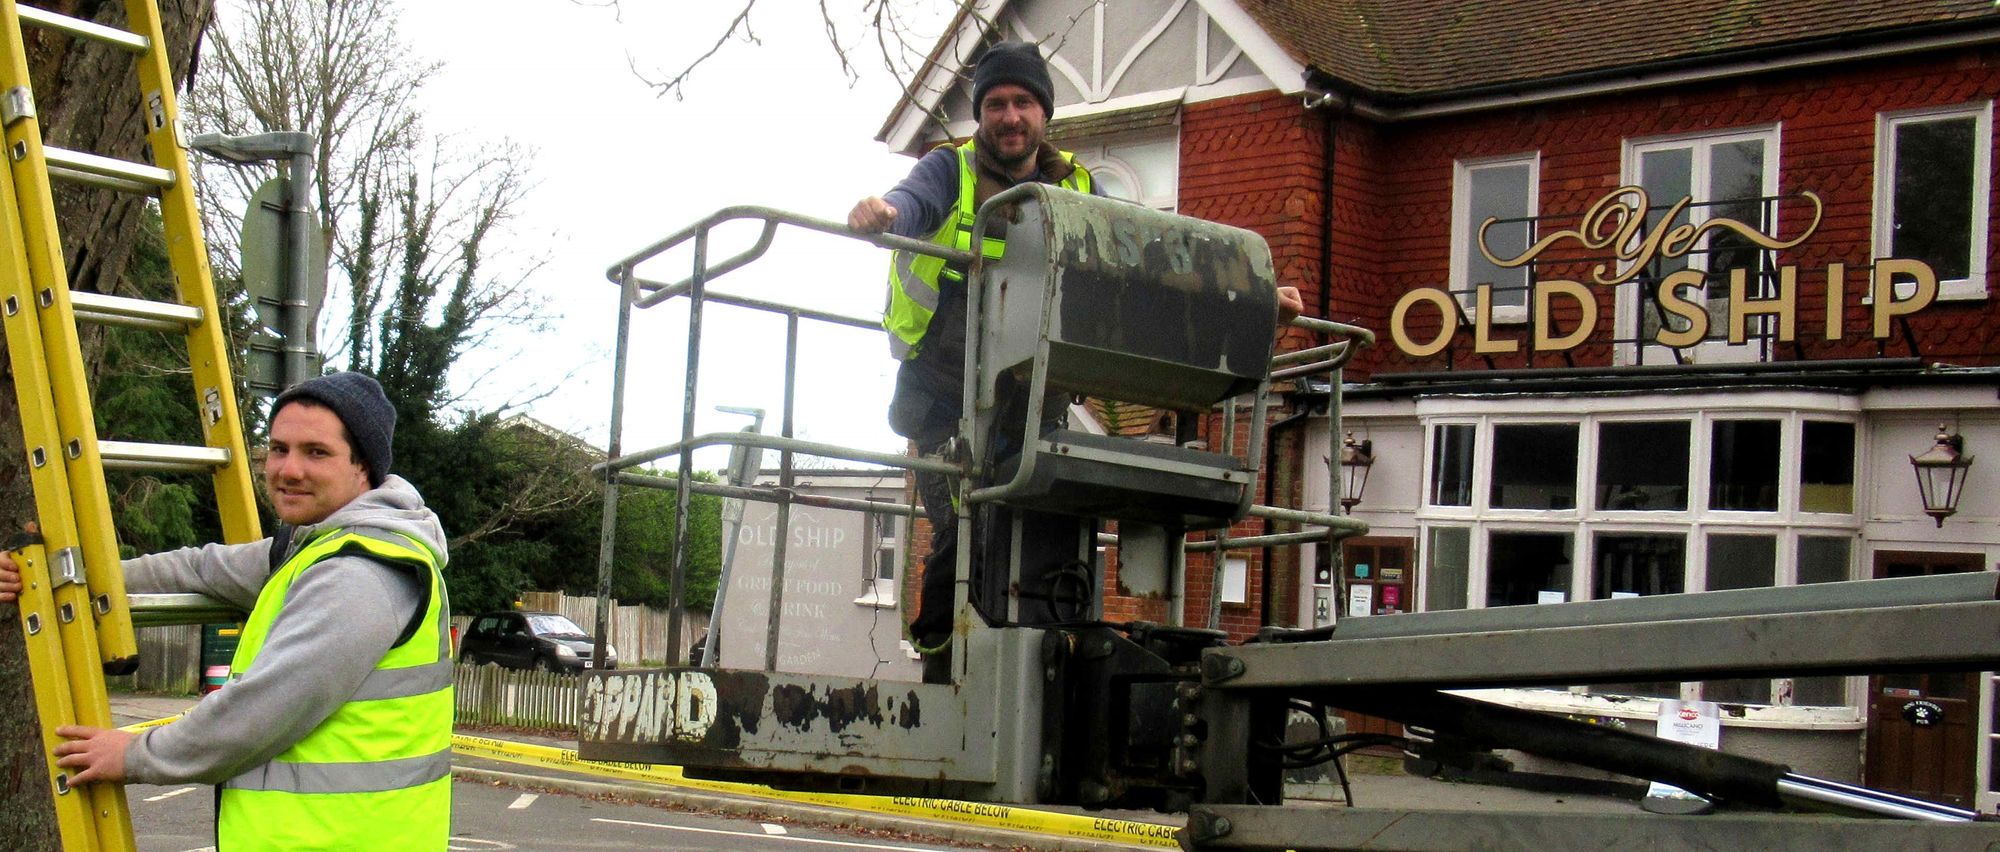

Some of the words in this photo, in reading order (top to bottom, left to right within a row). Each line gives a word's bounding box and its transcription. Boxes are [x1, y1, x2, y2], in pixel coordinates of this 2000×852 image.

[1389, 279, 1600, 358] OLD
[1654, 257, 1941, 349] SHIP
[793, 525, 845, 549] SHIP
[737, 575, 792, 593] GRET
[796, 578, 843, 596] FOOD
[783, 601, 827, 619] RINK
[893, 796, 938, 810] ELECTRIC
[940, 800, 972, 814] CABLE
[974, 803, 1011, 818] BELOW
[1094, 819, 1145, 836] ELECTRIC
[1147, 824, 1176, 840] CABL
